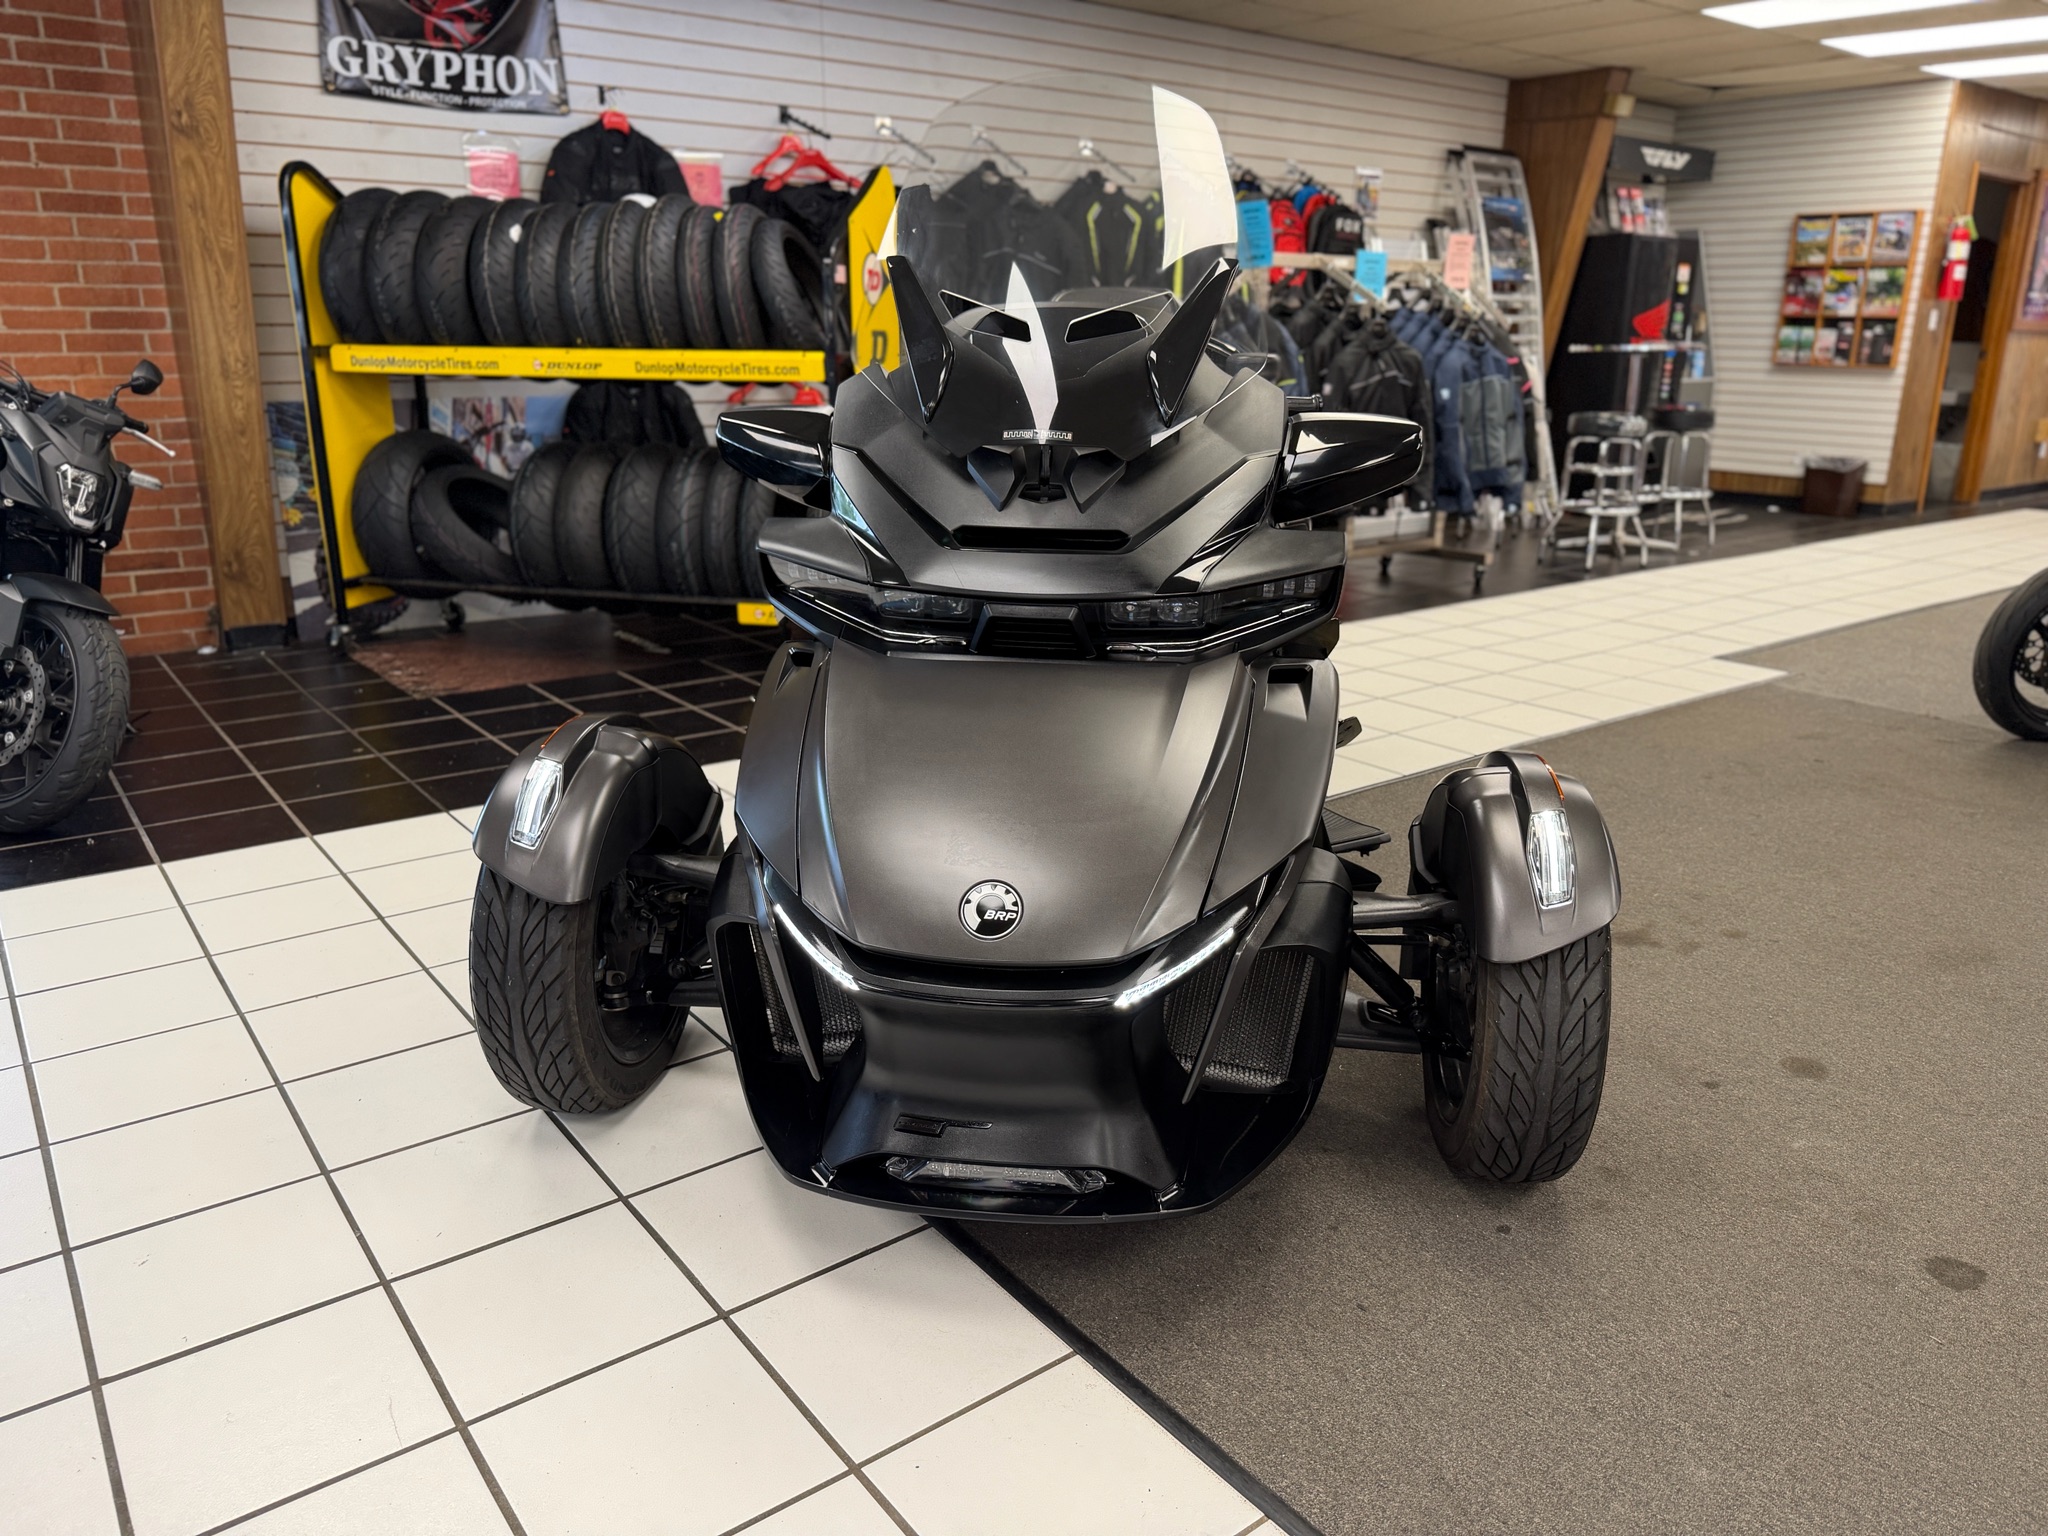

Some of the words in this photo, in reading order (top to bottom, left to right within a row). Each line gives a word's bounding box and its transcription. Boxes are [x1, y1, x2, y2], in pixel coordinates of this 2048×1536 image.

[326, 35, 559, 96] GRYPHON
[350, 355, 500, 371] DunlopMotorcycleTires.com
[546, 361, 603, 371] DUNLOP
[634, 361, 801, 377] DunlopMotorcycleTires.com
[983, 909, 1018, 922] BRP
